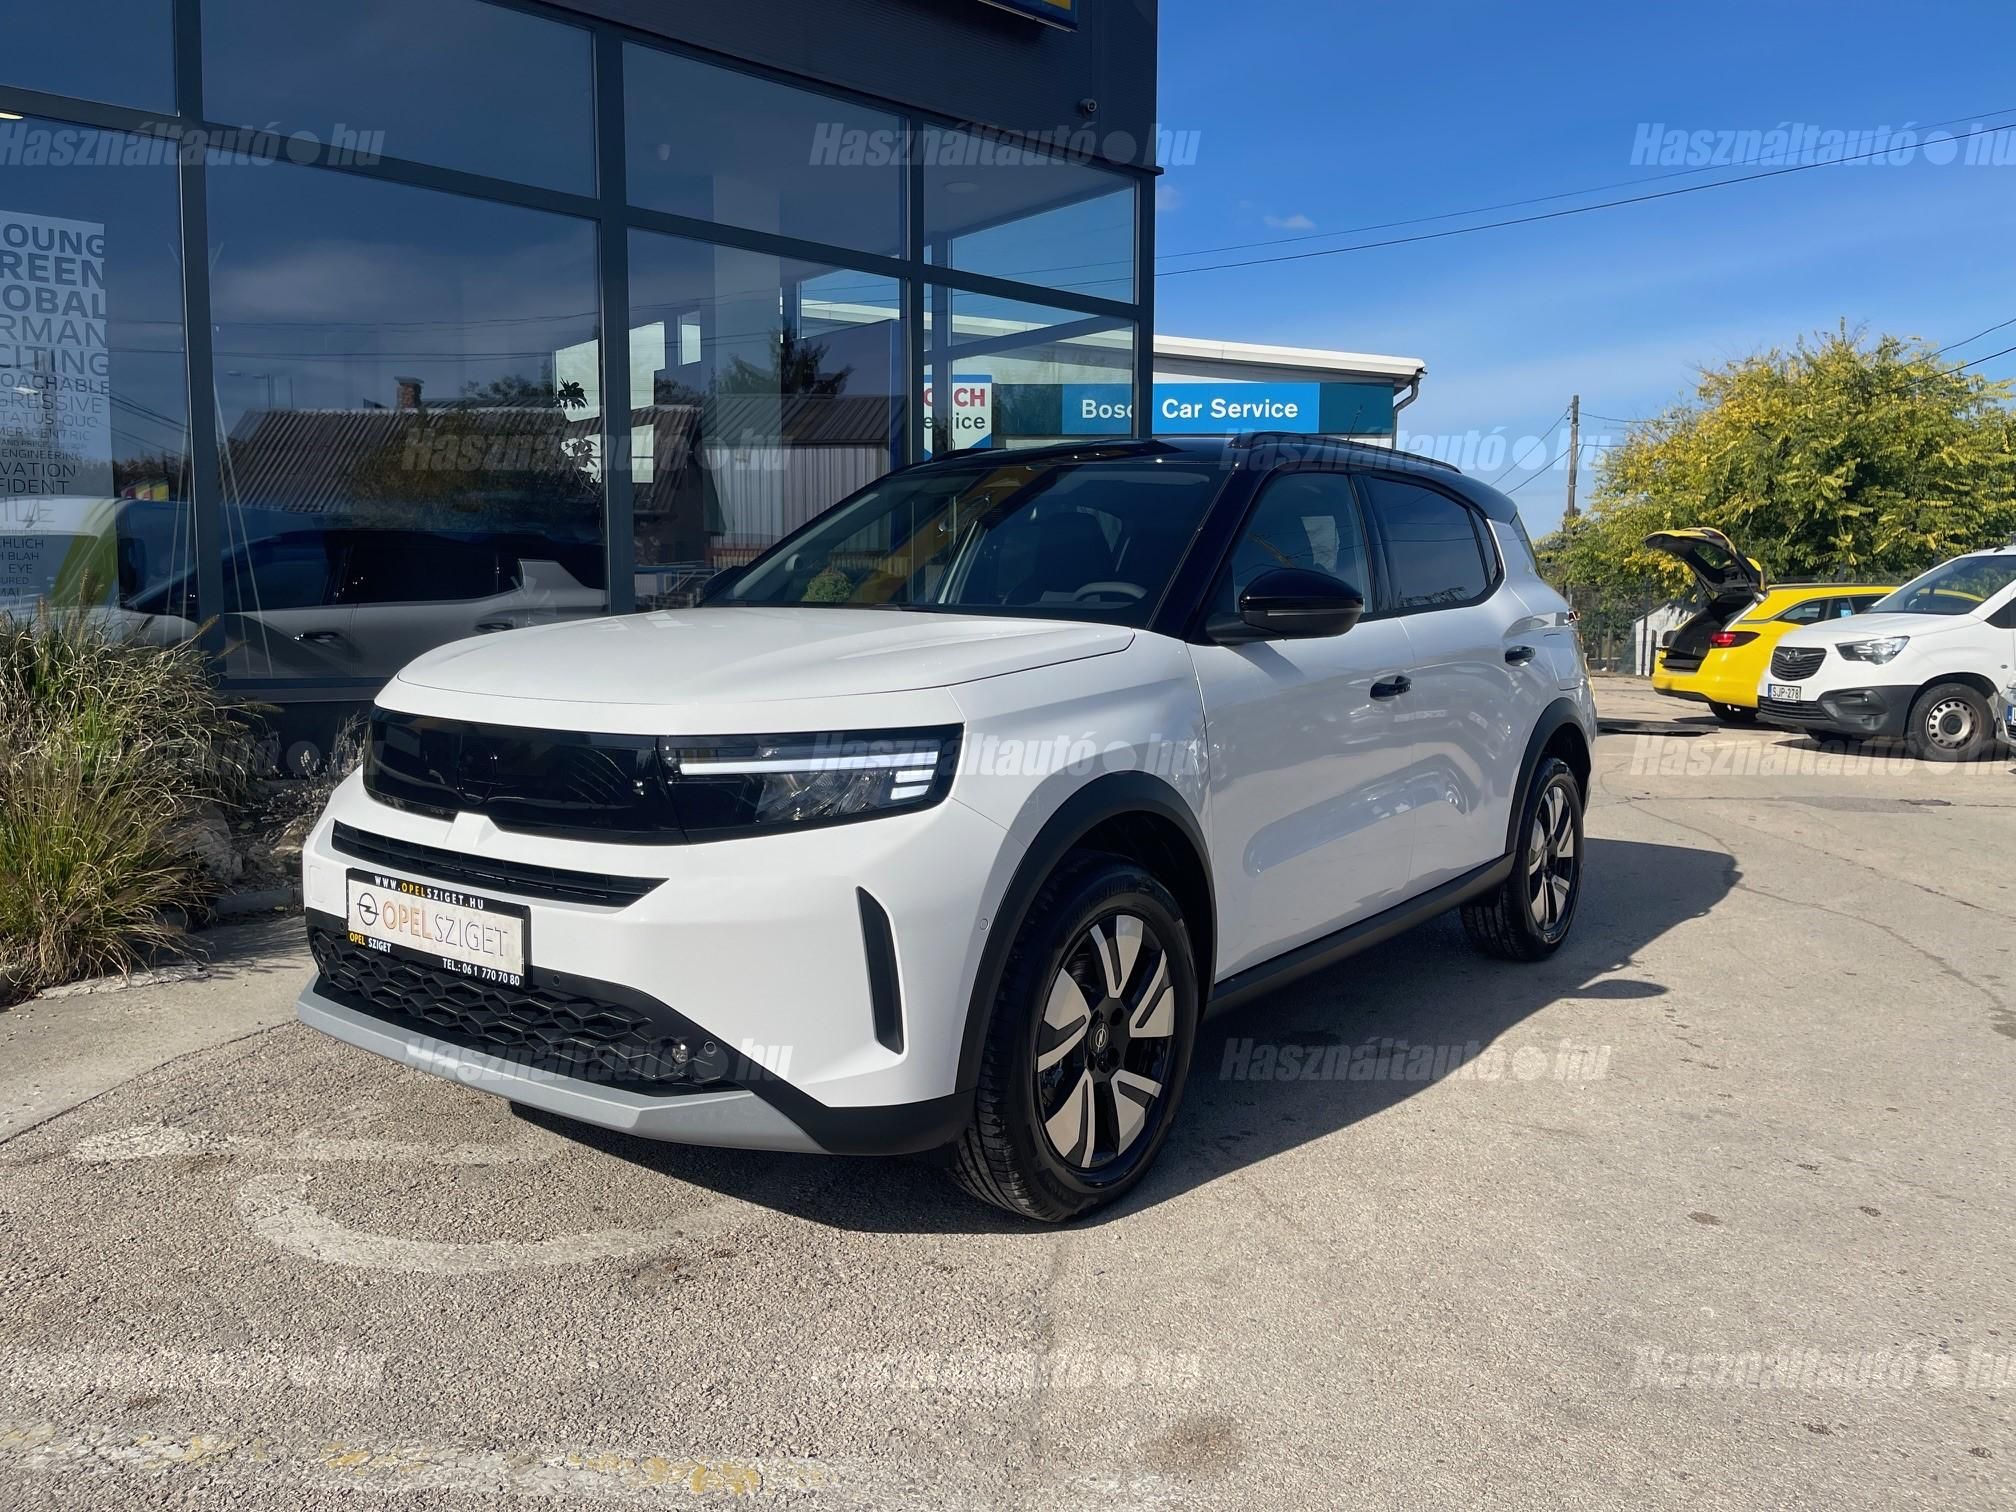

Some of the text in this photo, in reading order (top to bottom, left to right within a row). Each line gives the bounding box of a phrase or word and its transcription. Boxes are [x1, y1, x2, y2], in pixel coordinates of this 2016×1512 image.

[1162, 398, 1202, 418] Car
[1210, 398, 1298, 418] Service
[374, 875, 484, 910] WWW.OPELSZIGET.HU
[349, 932, 392, 953] OPEL SZIGET
[482, 967, 496, 981] 770
[498, 970, 508, 983] 70
[509, 974, 520, 986] 80
